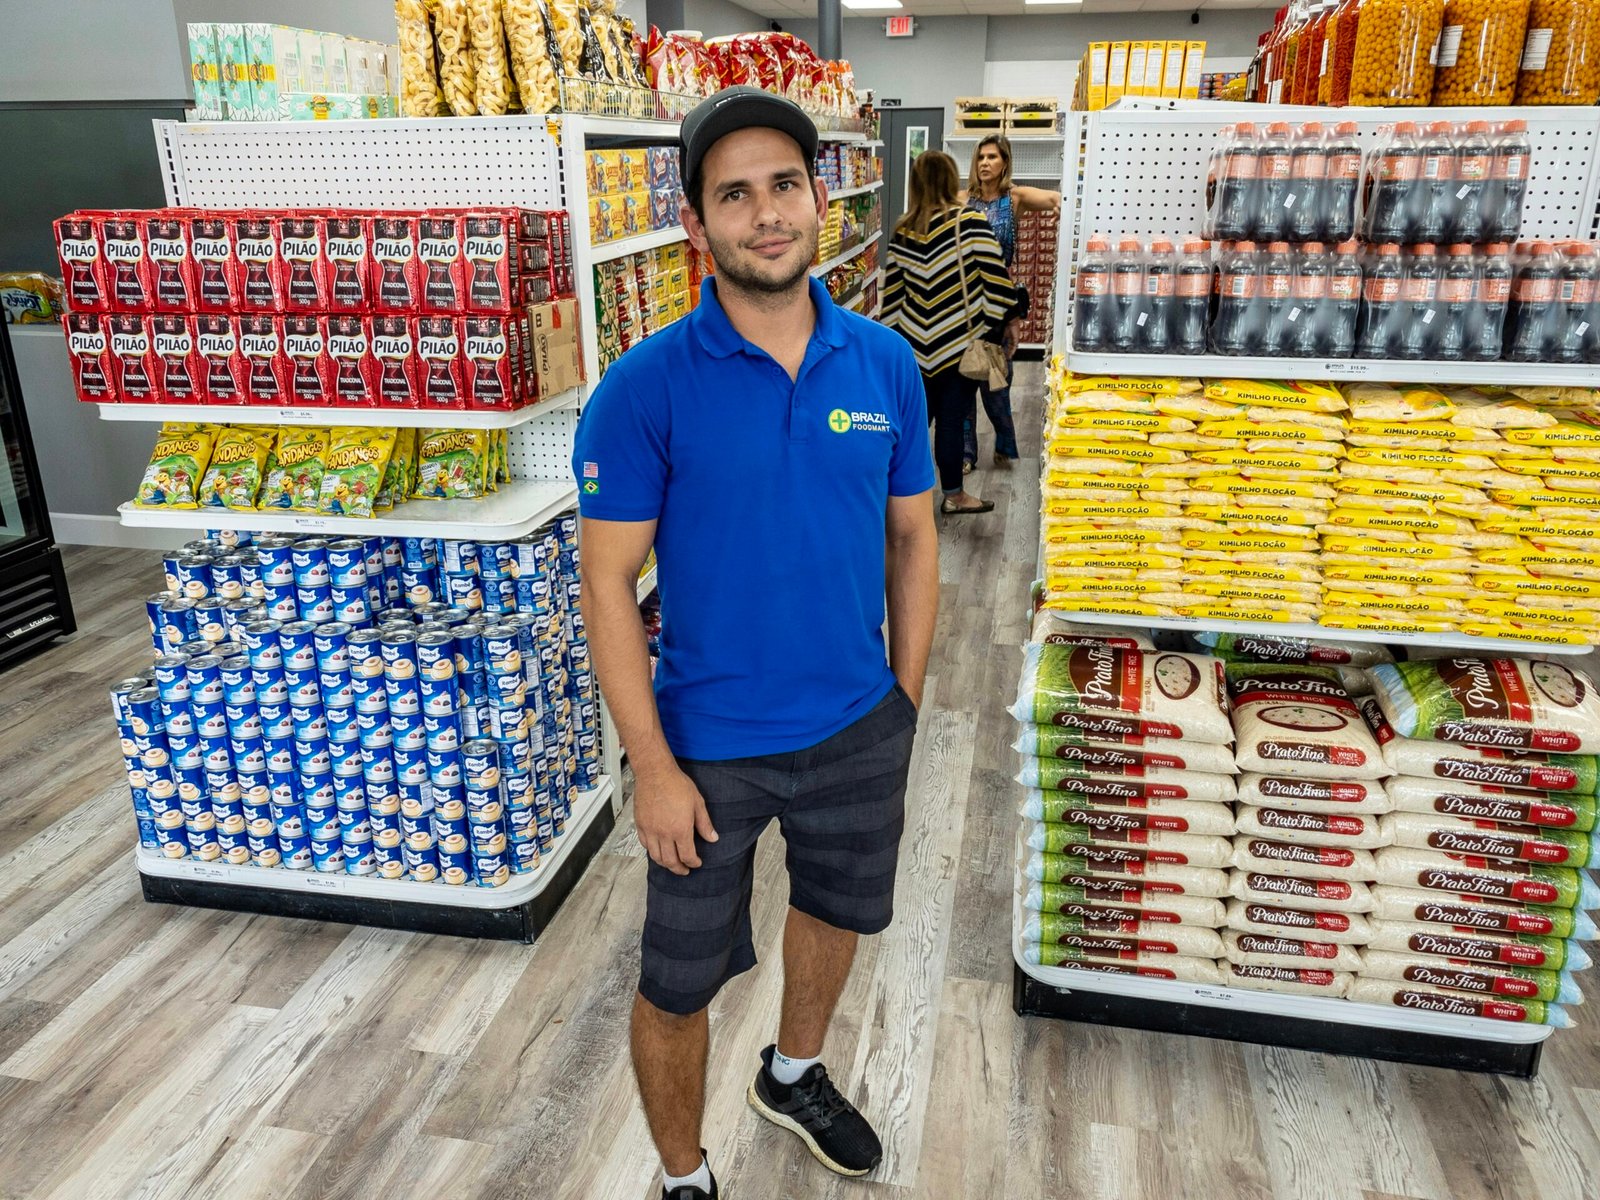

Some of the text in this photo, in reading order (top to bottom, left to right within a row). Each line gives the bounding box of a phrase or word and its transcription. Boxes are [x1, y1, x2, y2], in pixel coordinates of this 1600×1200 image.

[890, 17, 909, 33] EXIT
[63, 242, 96, 257] PILÃO
[107, 243, 141, 257] PILÃO
[150, 242, 183, 257] PILÃO
[194, 242, 228, 257] PILÃO
[239, 242, 272, 257] PILÃO
[283, 242, 317, 257] PILÃO
[328, 241, 363, 256] PILÃO
[375, 242, 411, 257] PILÃO
[420, 241, 456, 257] PILÃO
[466, 241, 503, 256] PILÃO
[72, 336, 104, 351] PILÃO
[114, 337, 147, 352] PILÃO
[156, 337, 190, 351] PILÃO
[200, 337, 233, 351] PILÃO
[242, 338, 276, 352] PILÃO
[287, 338, 321, 352] PILÃO
[330, 339, 365, 354] PILÃO
[374, 339, 410, 354] PILÃO
[420, 340, 456, 355] PILÃO
[467, 340, 504, 355] PILÃO
[1238, 392, 1270, 401] KIMILHO
[851, 412, 890, 424] BRAZIL
[852, 424, 890, 432] FOODMART
[1384, 427, 1419, 436] KIMILHO
[1228, 486, 1261, 494] KIMILHO
[1374, 488, 1409, 497] KIMILHO
[1369, 518, 1403, 526] KIMILHO
[1519, 526, 1556, 534] KIMILHO
[1221, 589, 1252, 597] KIMILHO
[1504, 611, 1540, 619] KIMILHO
[1498, 632, 1533, 640] KIMILHO
[1320, 652, 1341, 660] WHITE
[1128, 667, 1136, 686] WHITE
[1505, 672, 1519, 692] WHITE
[1148, 728, 1172, 736] WHITE
[1542, 737, 1568, 745] WHITE
[1151, 759, 1175, 767] WHITE
[1153, 789, 1176, 797] WHITE
[1541, 811, 1567, 819] WHITE
[1533, 848, 1559, 857] WHITE
[1523, 887, 1548, 896] WHITE
[1518, 921, 1544, 929] WHITE
[1511, 951, 1536, 960] WHITE
[1504, 983, 1529, 992] WHITE
[1493, 1008, 1517, 1017] WHITE
